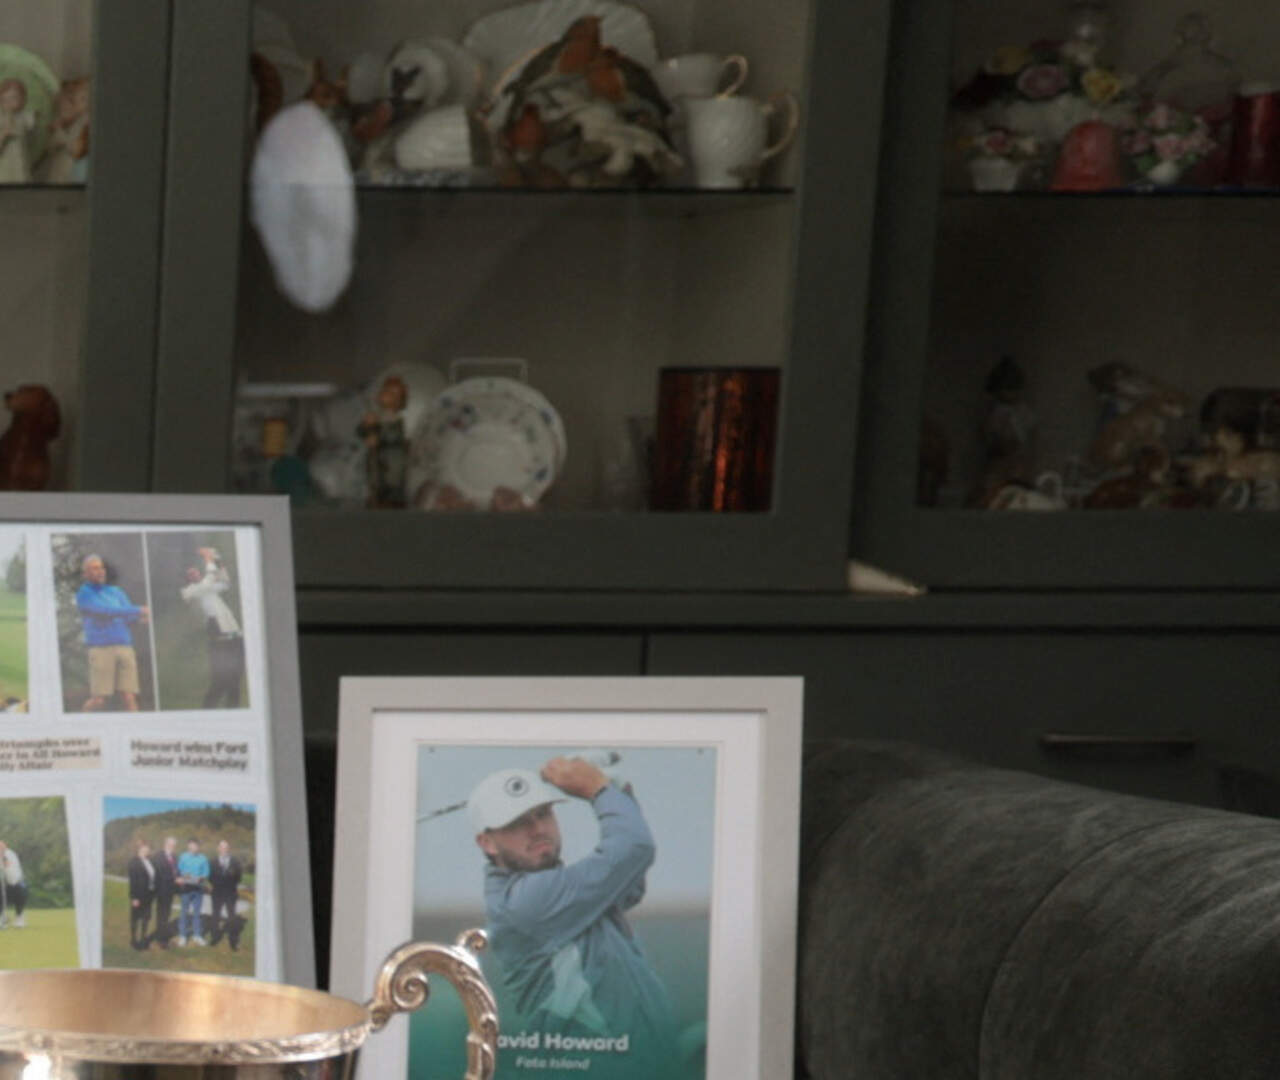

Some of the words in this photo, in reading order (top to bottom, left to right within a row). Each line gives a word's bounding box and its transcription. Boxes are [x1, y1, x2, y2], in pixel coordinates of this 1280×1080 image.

[497, 1033, 540, 1050] avid
[545, 1033, 630, 1051] Howard
[550, 1058, 591, 1070] Island
